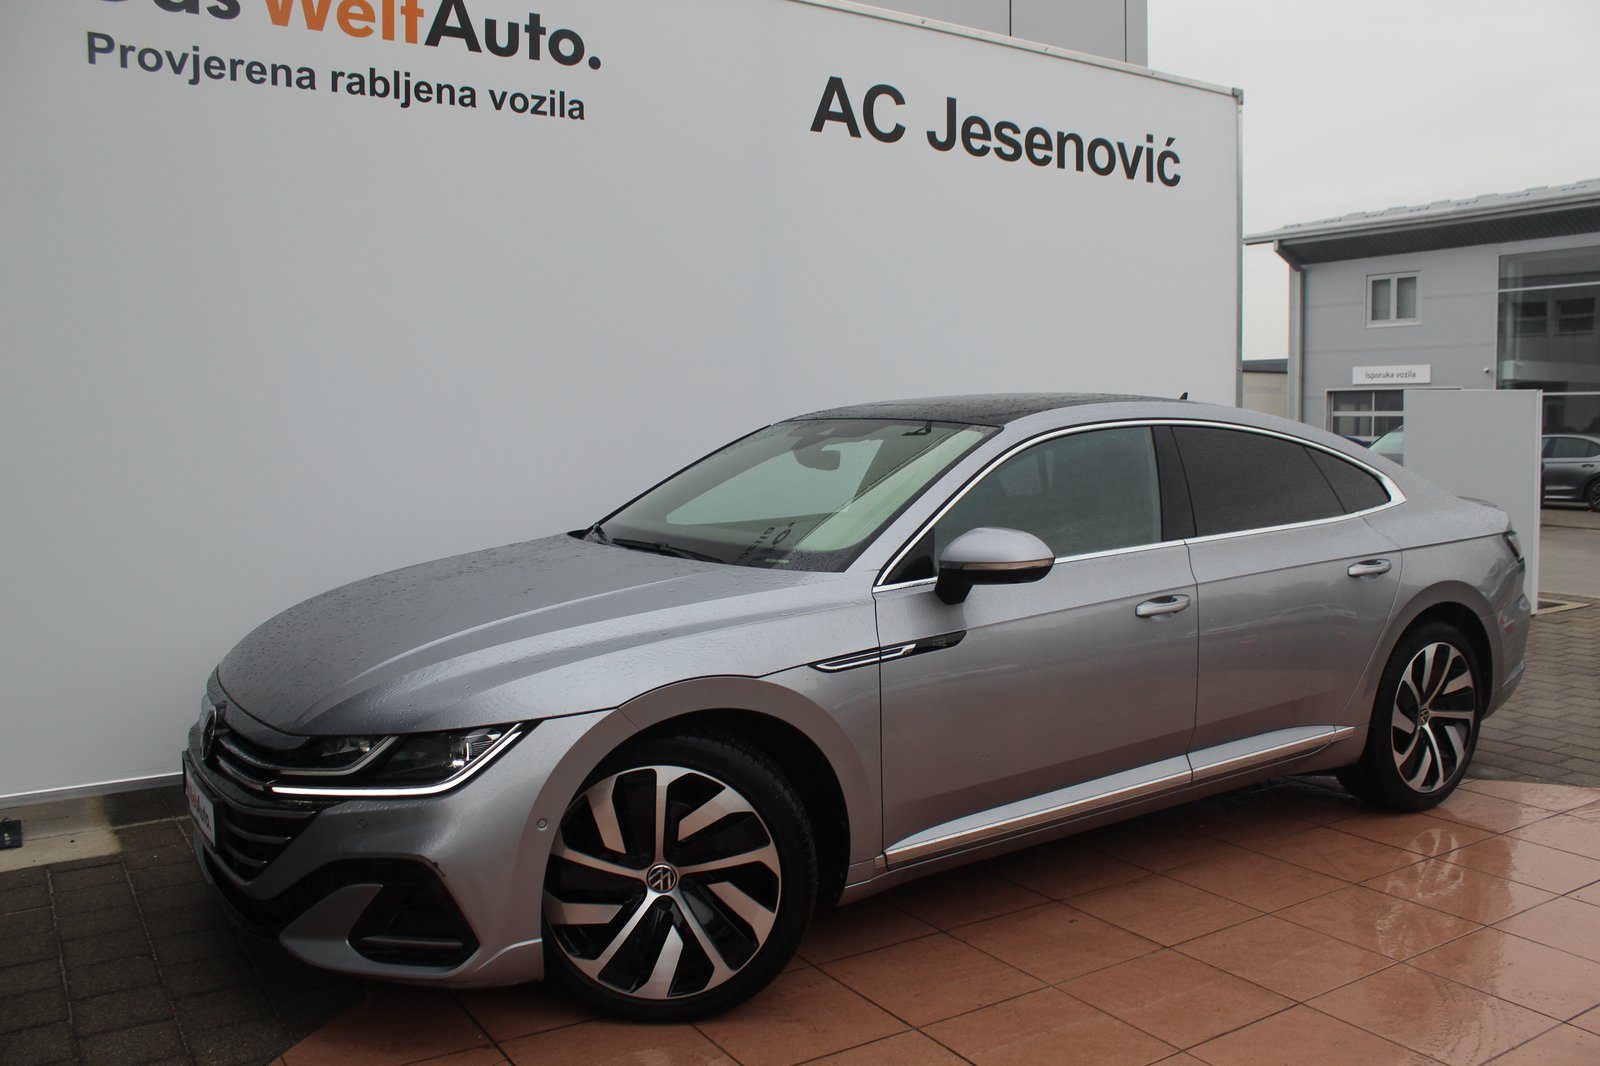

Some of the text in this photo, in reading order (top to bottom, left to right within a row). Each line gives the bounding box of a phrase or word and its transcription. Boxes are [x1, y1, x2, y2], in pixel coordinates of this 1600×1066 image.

[86, 31, 585, 121] Provjerena rabljena vozila
[809, 75, 1181, 187] AC Jesenović
[1364, 370, 1417, 380] Isporuka vozila
